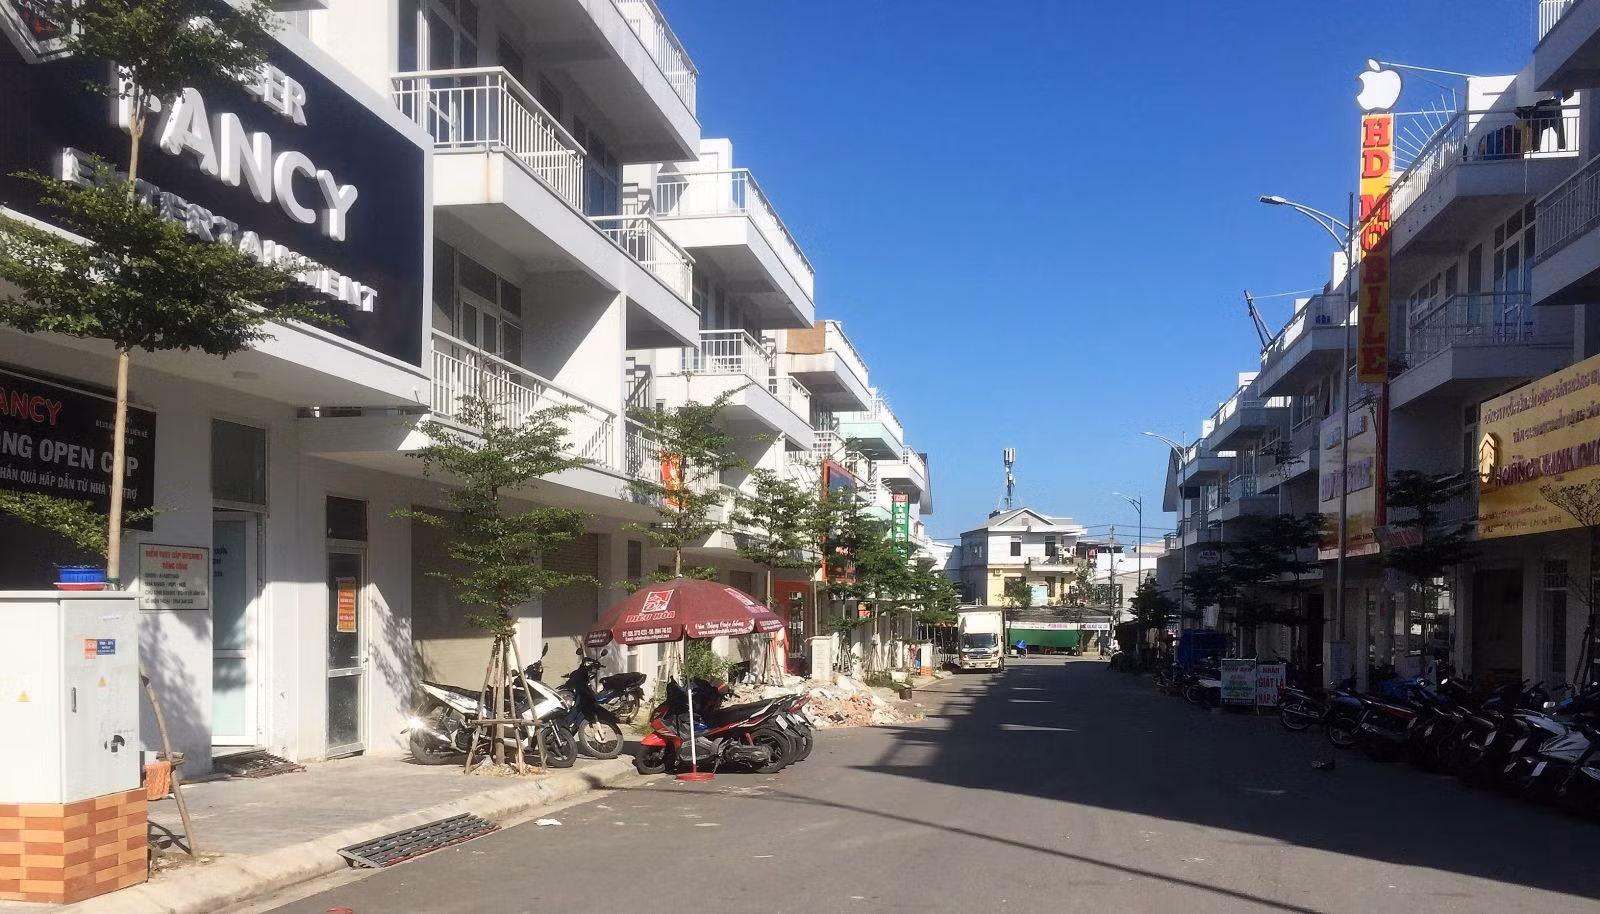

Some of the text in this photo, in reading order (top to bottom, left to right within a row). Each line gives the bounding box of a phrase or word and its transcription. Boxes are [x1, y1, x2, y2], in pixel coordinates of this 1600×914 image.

[1361, 116, 1391, 178] HD
[1359, 193, 1391, 375] MOBILE
[20, 469, 37, 484] QUÀ
[39, 471, 55, 487] HẤP
[58, 473, 75, 490] DẪN
[90, 481, 106, 495] NHÀ
[39, 439, 94, 470] OPEN
[100, 451, 139, 477] CP
